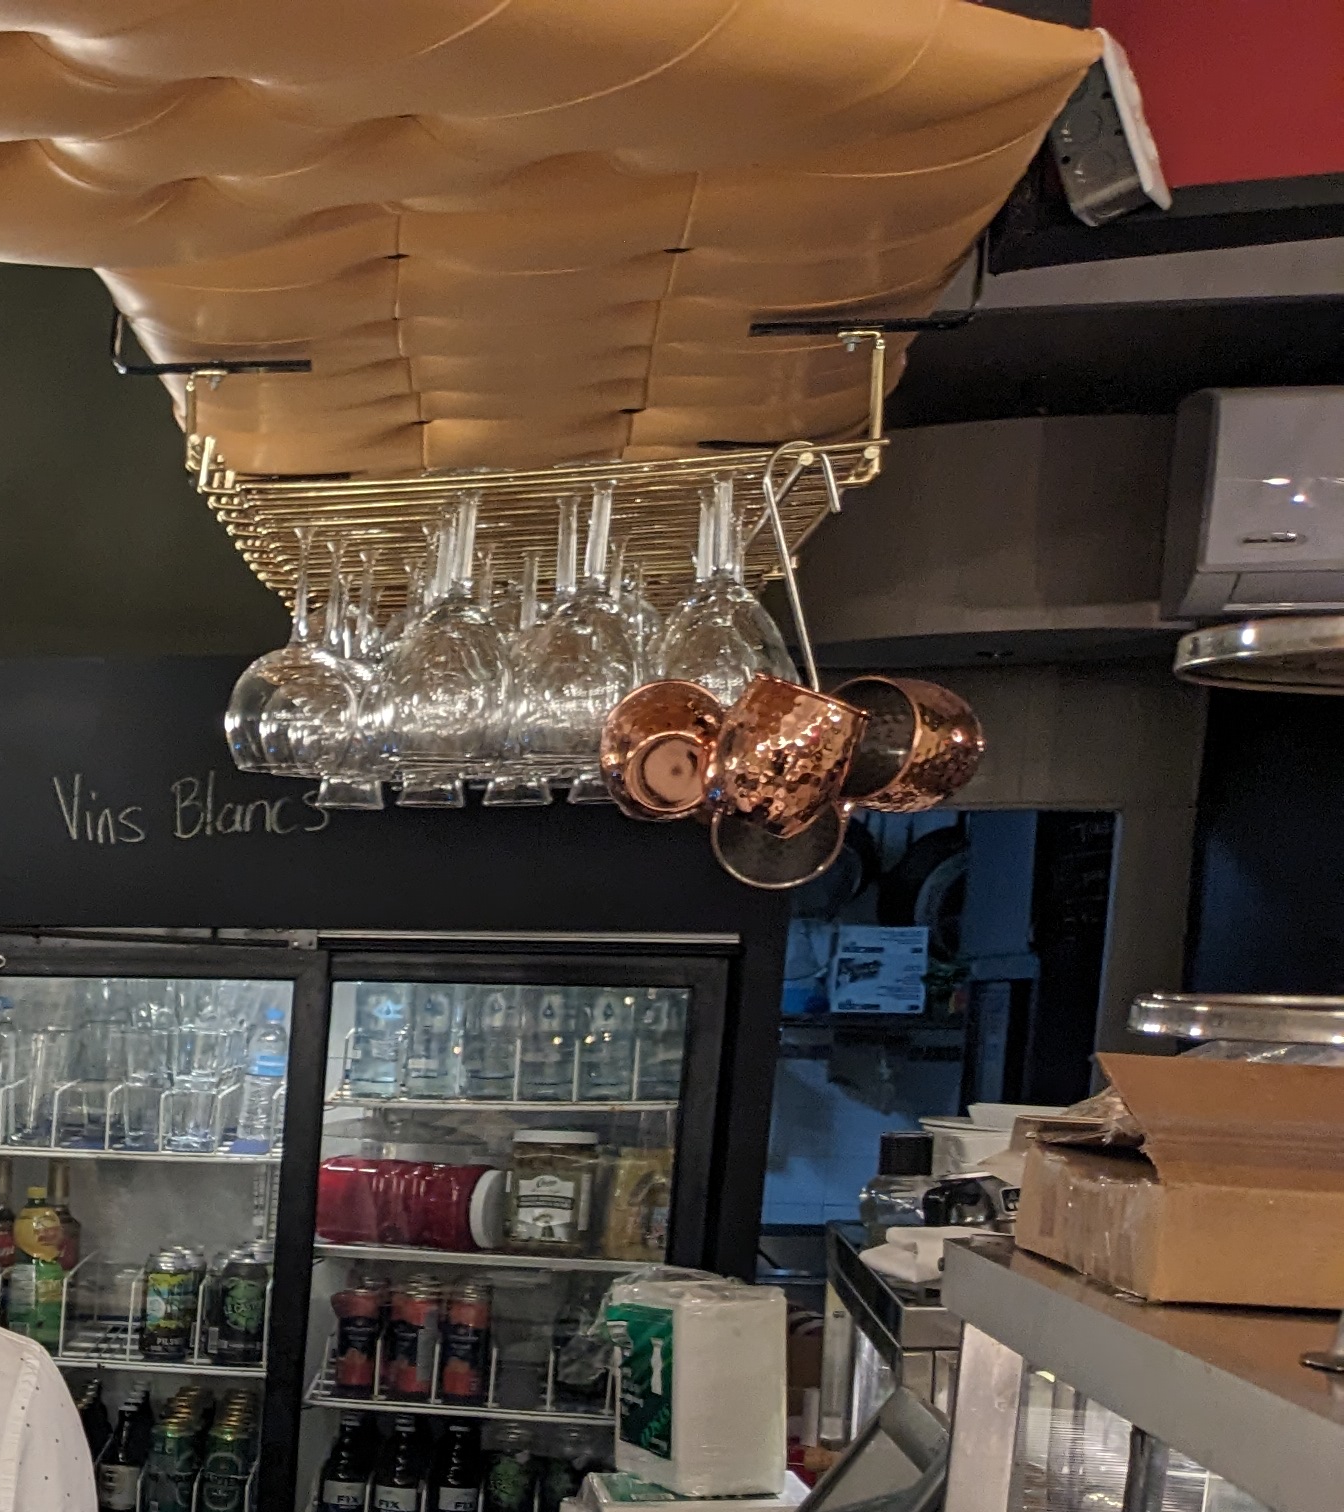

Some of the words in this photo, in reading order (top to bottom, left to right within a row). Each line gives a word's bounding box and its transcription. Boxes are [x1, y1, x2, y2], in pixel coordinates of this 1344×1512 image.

[52, 773, 146, 845] Vins
[170, 769, 331, 839] Blancs
[336, 1494, 360, 1503] FIX
[378, 1500, 400, 1509] FIX
